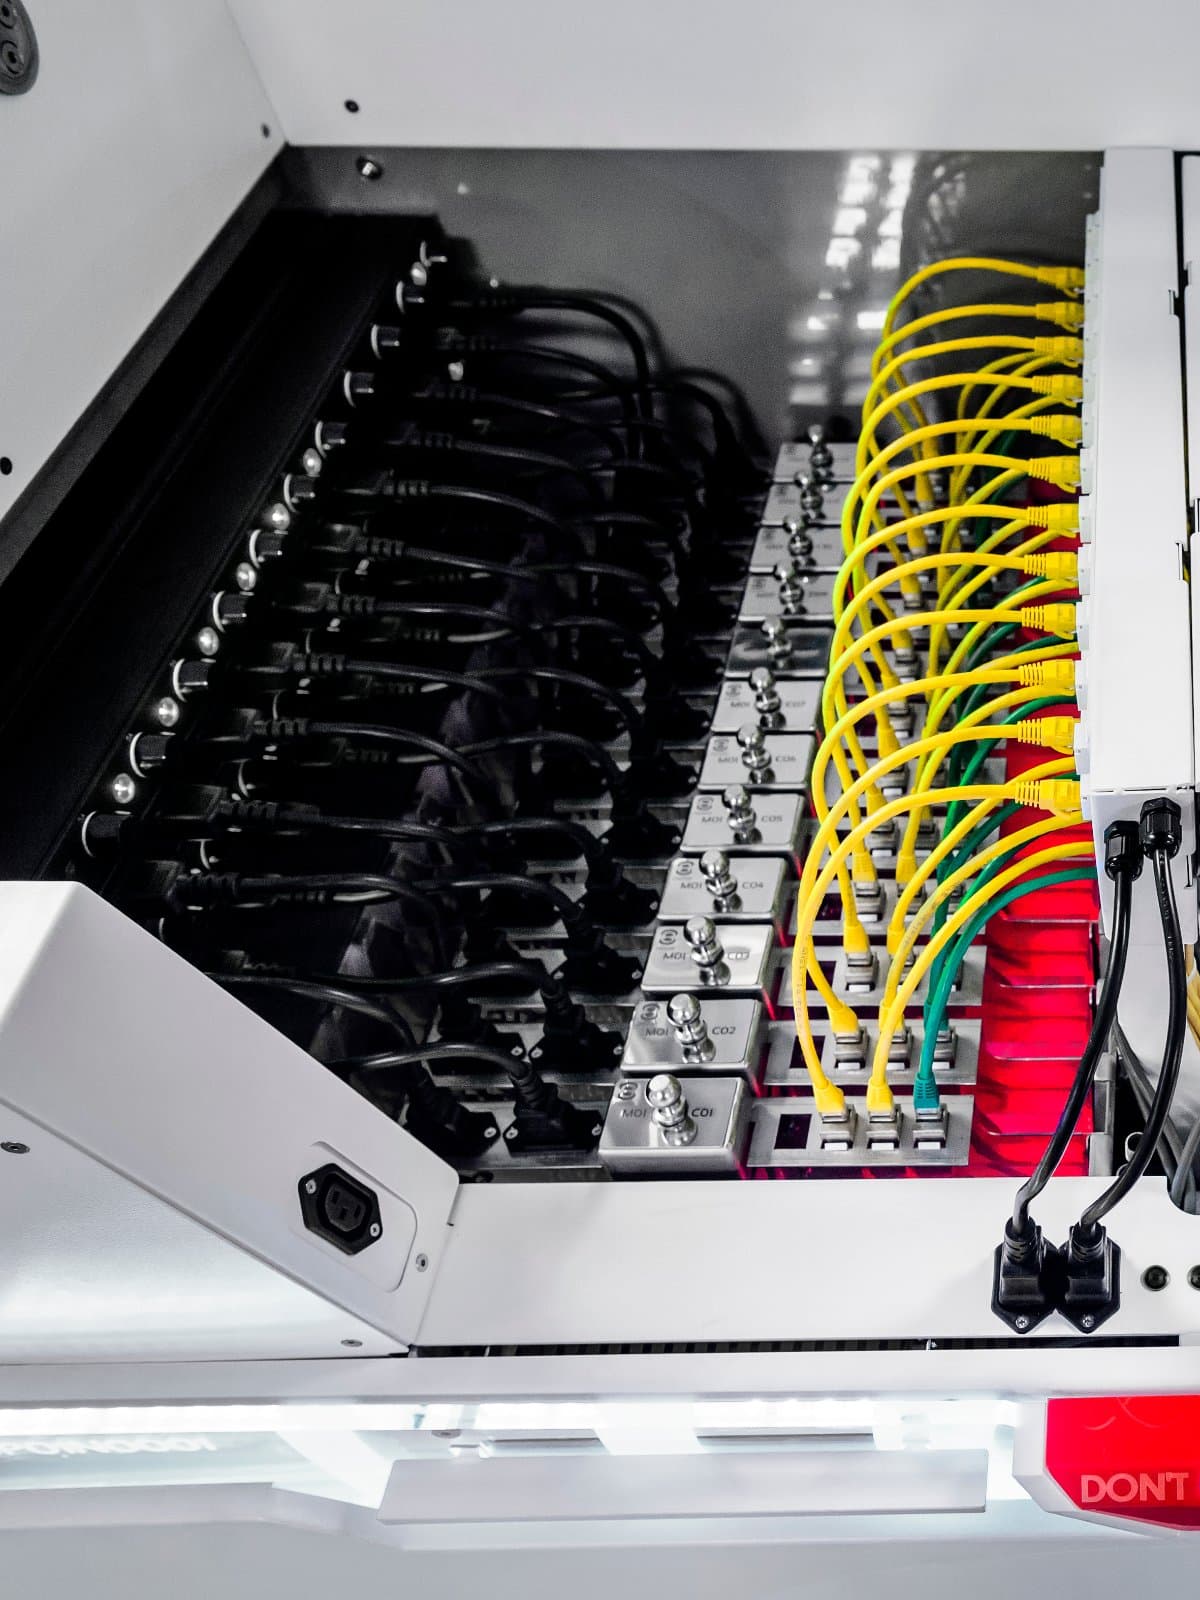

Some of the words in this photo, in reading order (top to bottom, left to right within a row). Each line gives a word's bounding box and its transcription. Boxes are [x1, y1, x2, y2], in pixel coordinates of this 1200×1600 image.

[712, 1026, 736, 1035] C02
[691, 1107, 714, 1118] C01
[1080, 1471, 1190, 1503] DON'T
